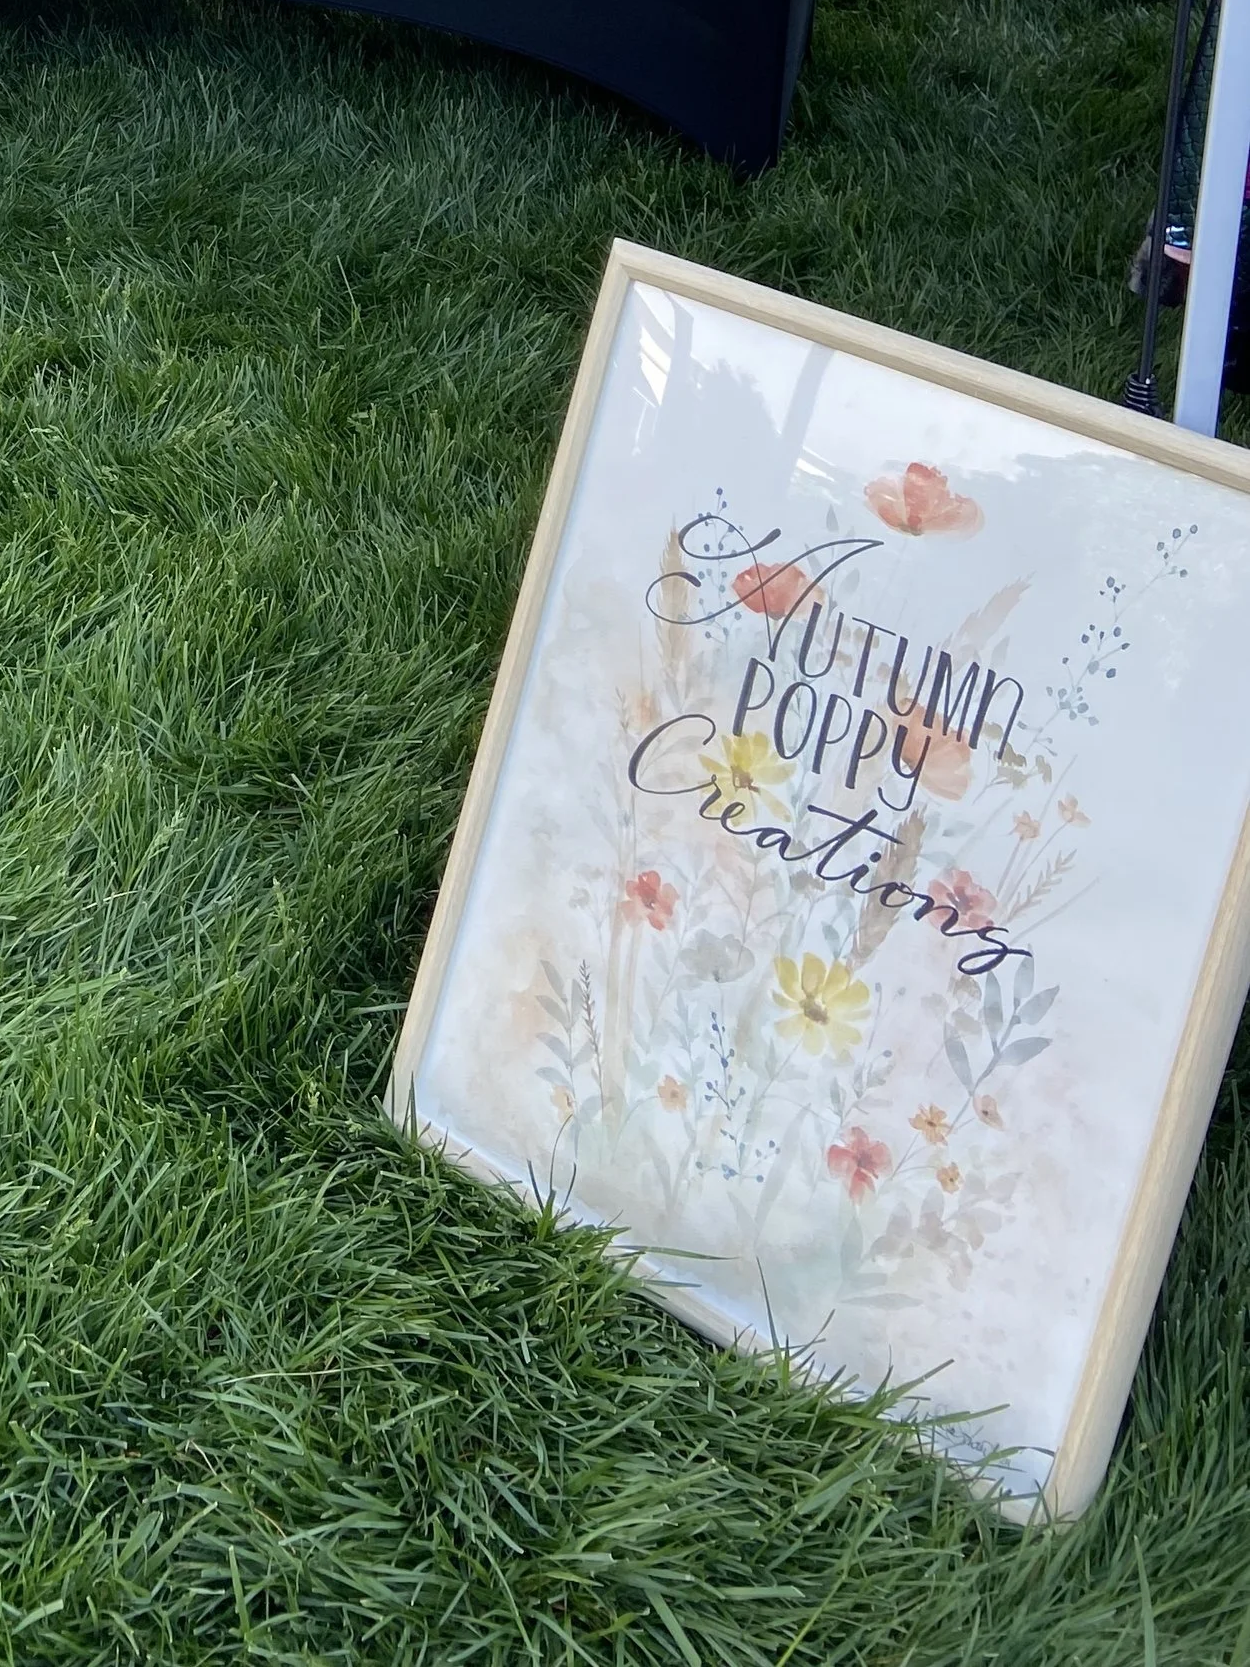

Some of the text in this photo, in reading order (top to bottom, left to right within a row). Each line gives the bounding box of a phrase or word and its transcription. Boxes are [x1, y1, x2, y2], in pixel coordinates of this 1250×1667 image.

[646, 514, 1025, 760] AUTUMN
[732, 656, 932, 812] POPPY
[628, 713, 1033, 976] Creations
